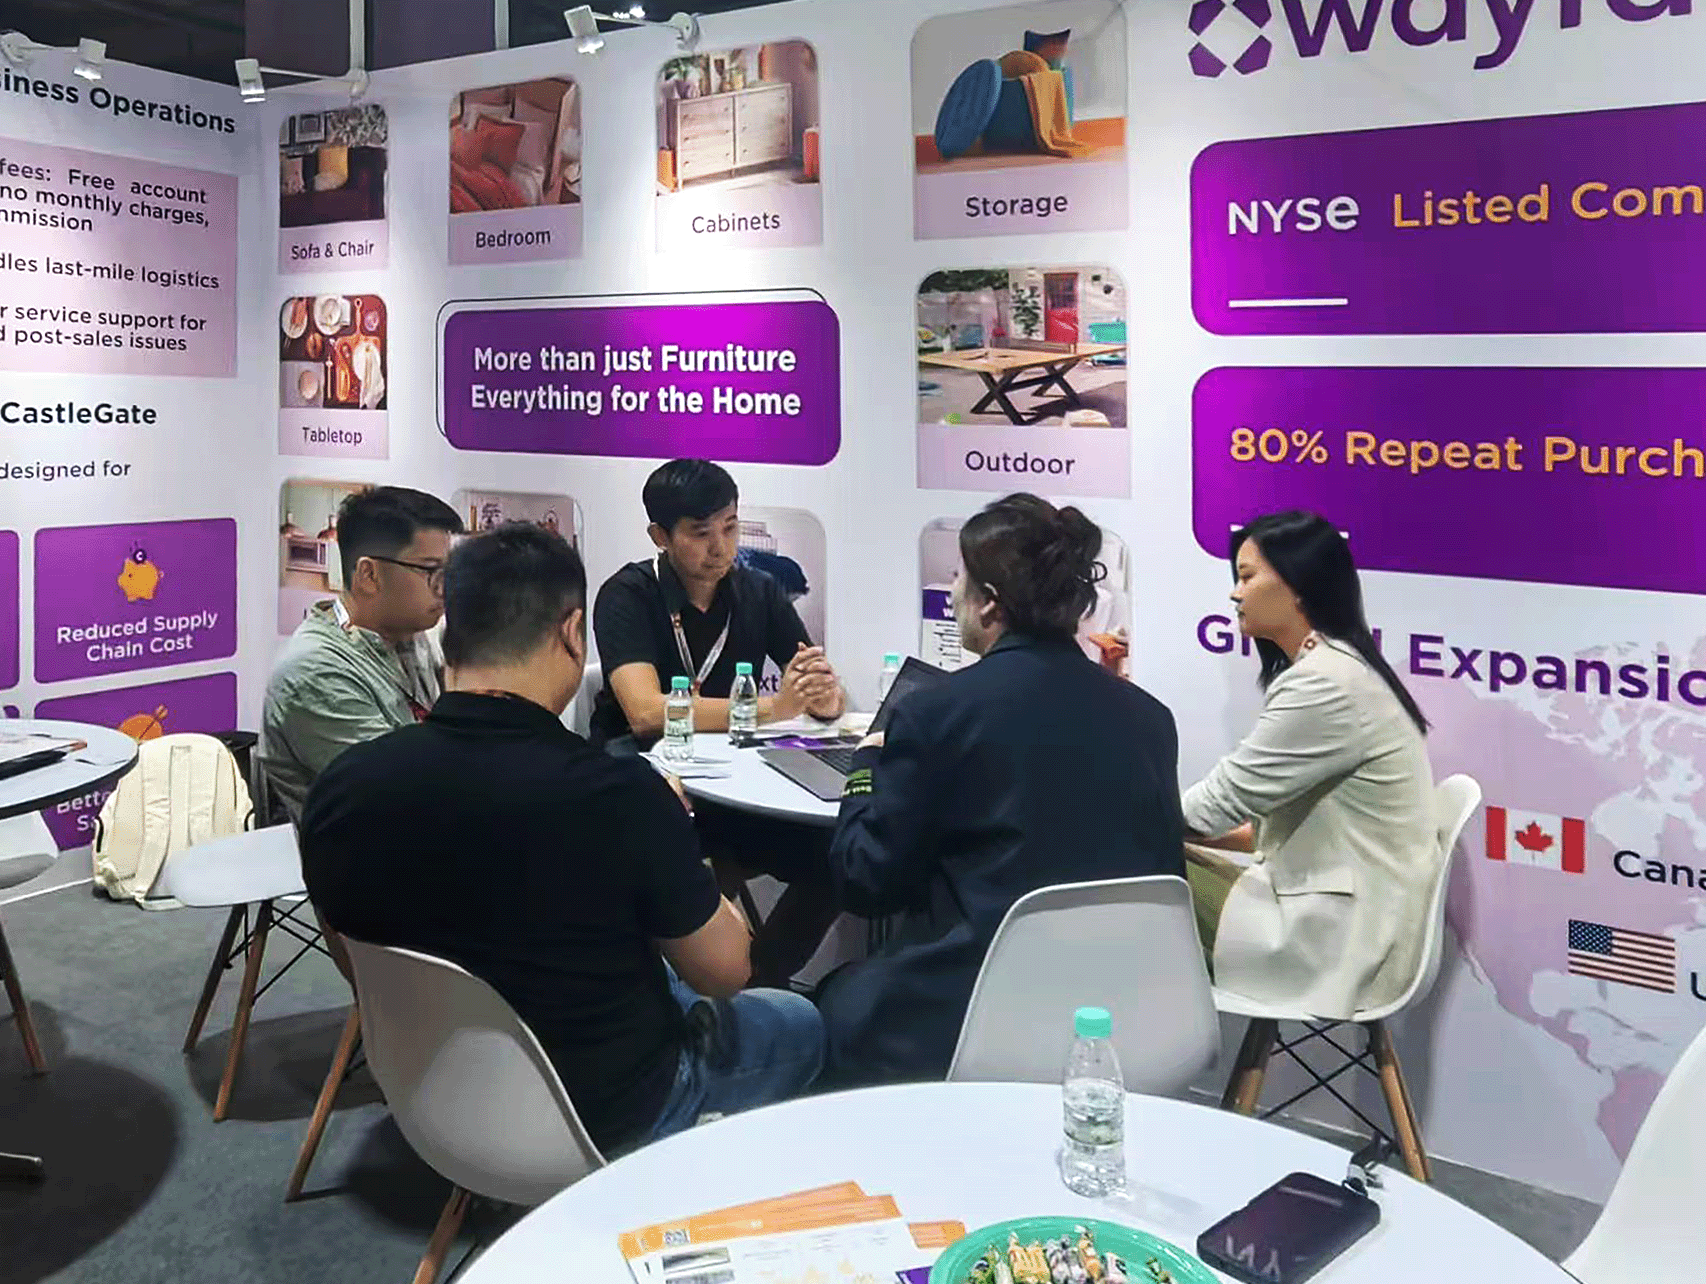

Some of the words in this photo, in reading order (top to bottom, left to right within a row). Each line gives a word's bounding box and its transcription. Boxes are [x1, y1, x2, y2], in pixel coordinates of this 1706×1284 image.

[1280, 0, 1693, 69] way
[0, 68, 79, 104] iness
[89, 87, 236, 133] Operations
[0, 158, 51, 181] fees:
[69, 169, 115, 190] Free
[130, 181, 207, 203] account
[0, 186, 27, 201] no
[36, 190, 122, 216] monthly
[129, 202, 209, 227] charges,
[966, 195, 1068, 217] Storage
[1394, 184, 1550, 227] Listed
[1571, 181, 1705, 219] Com
[692, 212, 780, 234] Cabinets
[291, 244, 321, 260] Sofa
[324, 242, 334, 257] &
[338, 240, 375, 256] Chair
[476, 230, 551, 248] Bedroom
[46, 257, 135, 281] last-mile
[141, 266, 219, 289] logistics
[15, 306, 92, 324] service
[98, 311, 174, 330] support
[180, 314, 207, 331] for
[15, 329, 123, 347] post-sales
[130, 332, 187, 351] issues
[474, 347, 532, 371] More
[540, 345, 595, 371] than
[603, 345, 652, 376] just
[661, 343, 796, 373] Furniture
[0, 402, 157, 424] CastleGate
[472, 385, 602, 415] Everything
[611, 386, 650, 412] for
[657, 386, 703, 413] the
[713, 387, 801, 415] Home
[302, 427, 363, 446] Tabletop
[965, 451, 1075, 475] Outdoor
[1230, 427, 1329, 464] 80%
[1346, 431, 1524, 473] Repeat
[1544, 435, 1705, 478] Purch
[0, 461, 96, 482] designed
[103, 460, 132, 477] for
[57, 617, 148, 644] Reduced
[153, 610, 219, 632] Supply
[86, 641, 143, 662] Chain
[150, 634, 193, 653] Cost
